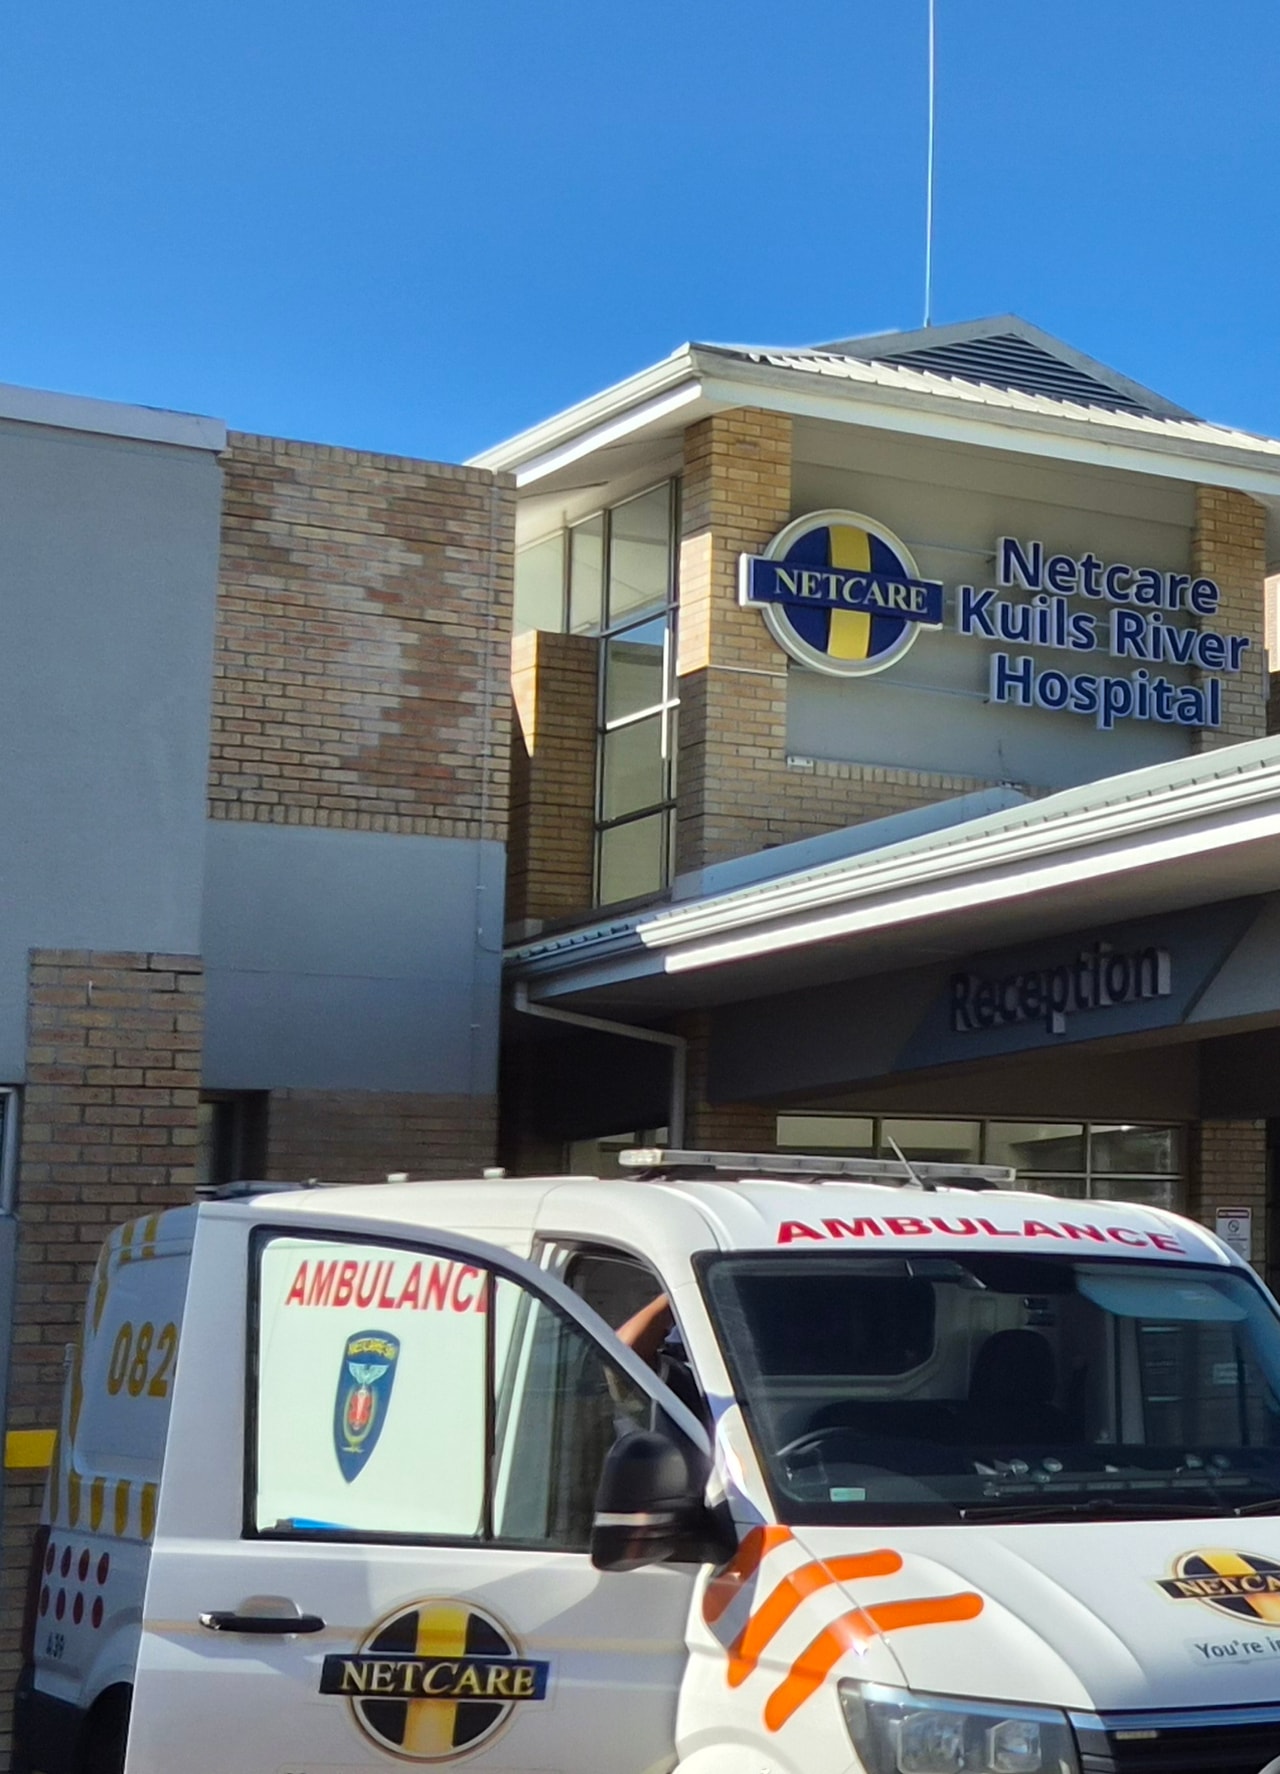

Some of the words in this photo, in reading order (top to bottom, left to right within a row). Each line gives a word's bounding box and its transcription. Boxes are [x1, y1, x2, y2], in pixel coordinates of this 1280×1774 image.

[774, 567, 928, 615] NETCARE
[997, 534, 1219, 616] Netcare
[957, 586, 1098, 653] Kuils
[1110, 605, 1250, 673] River
[989, 651, 1221, 731] Hospital
[951, 941, 1173, 1035] Reception
[777, 1215, 1187, 1255] AMBULANCE
[107, 1320, 178, 1398] 082
[341, 1659, 537, 1696] NETCARE
[1194, 1637, 1262, 1660] You're
